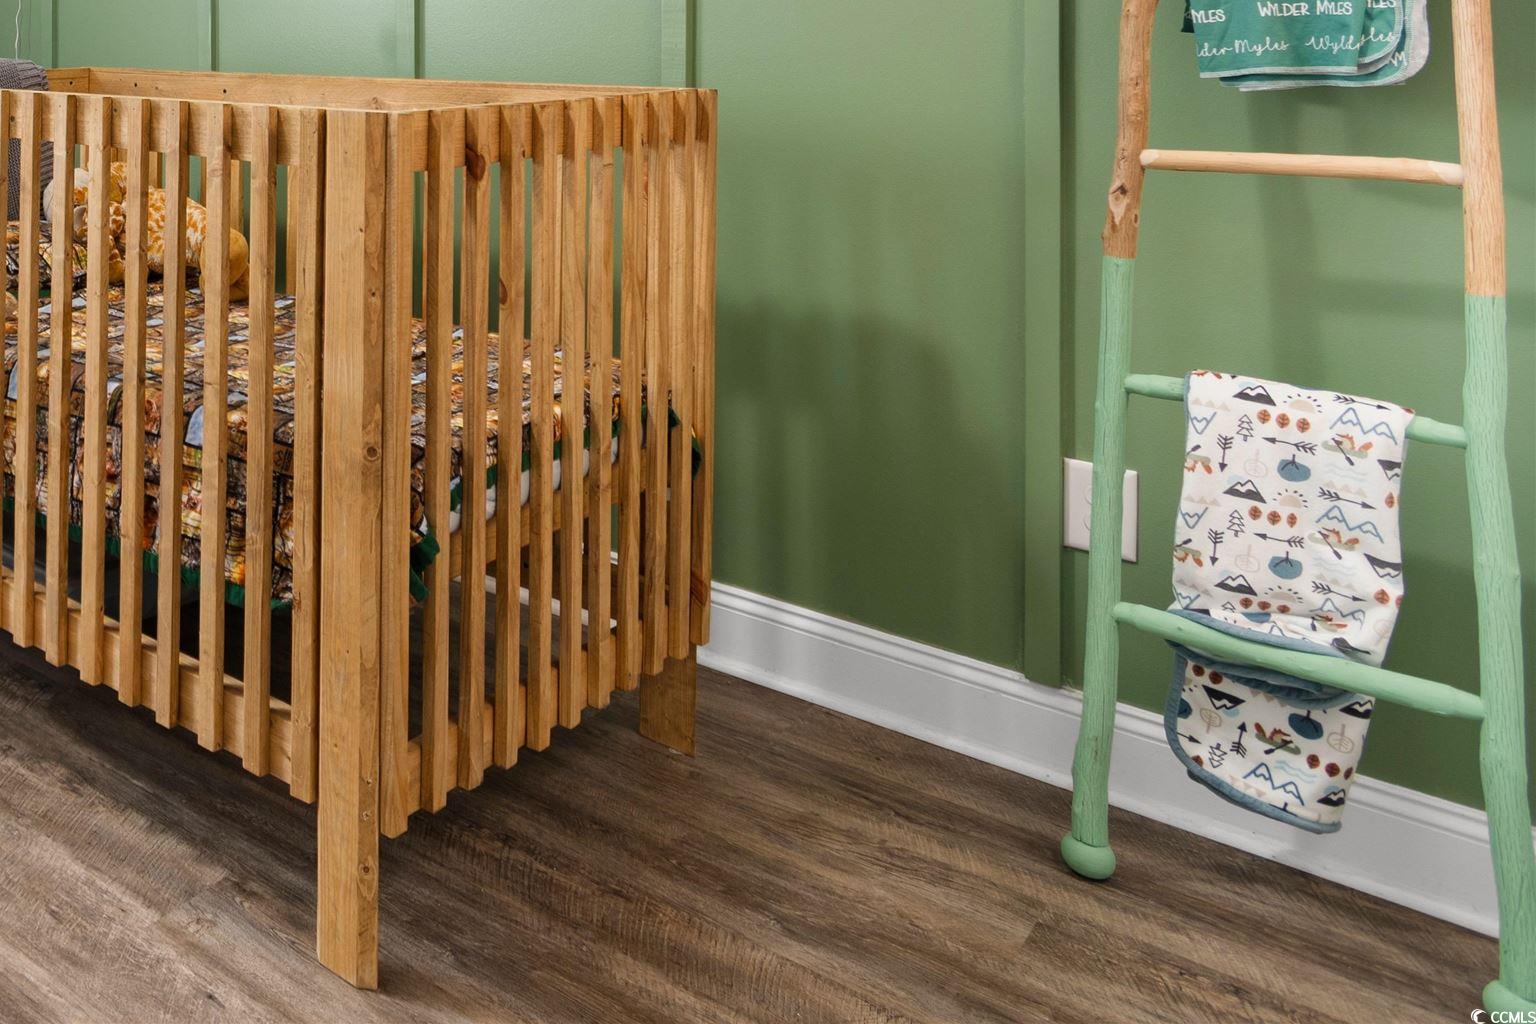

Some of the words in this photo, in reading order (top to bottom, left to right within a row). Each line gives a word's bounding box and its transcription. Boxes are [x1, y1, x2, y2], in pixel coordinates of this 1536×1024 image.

[1316, 0, 1353, 16] MYLES
[1234, 36, 1290, 56] Myles
[1305, 34, 1361, 55] Wyld
